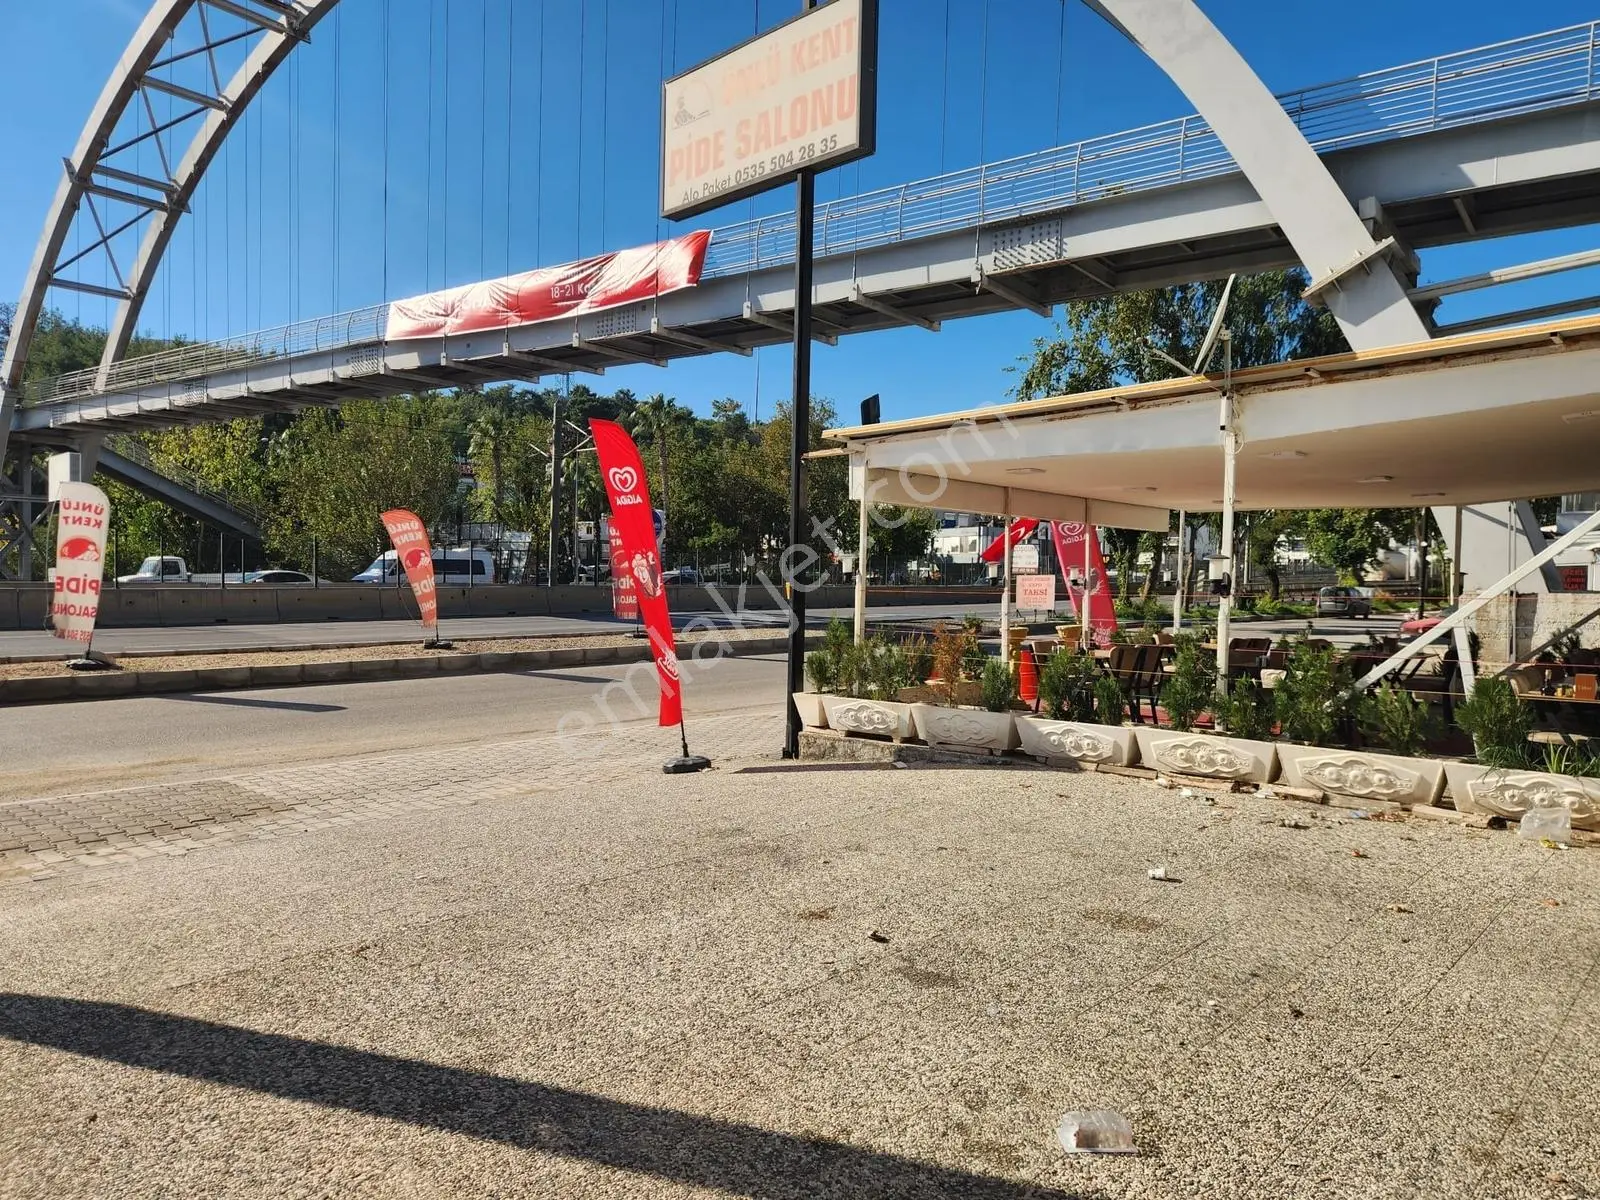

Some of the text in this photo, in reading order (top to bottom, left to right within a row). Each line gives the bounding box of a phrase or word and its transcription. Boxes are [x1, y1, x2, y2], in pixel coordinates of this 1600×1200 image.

[791, 17, 857, 75] KENT
[669, 74, 857, 187] PİDE SALONU
[682, 134, 838, 204] Alo Paket 0535 504 28 35
